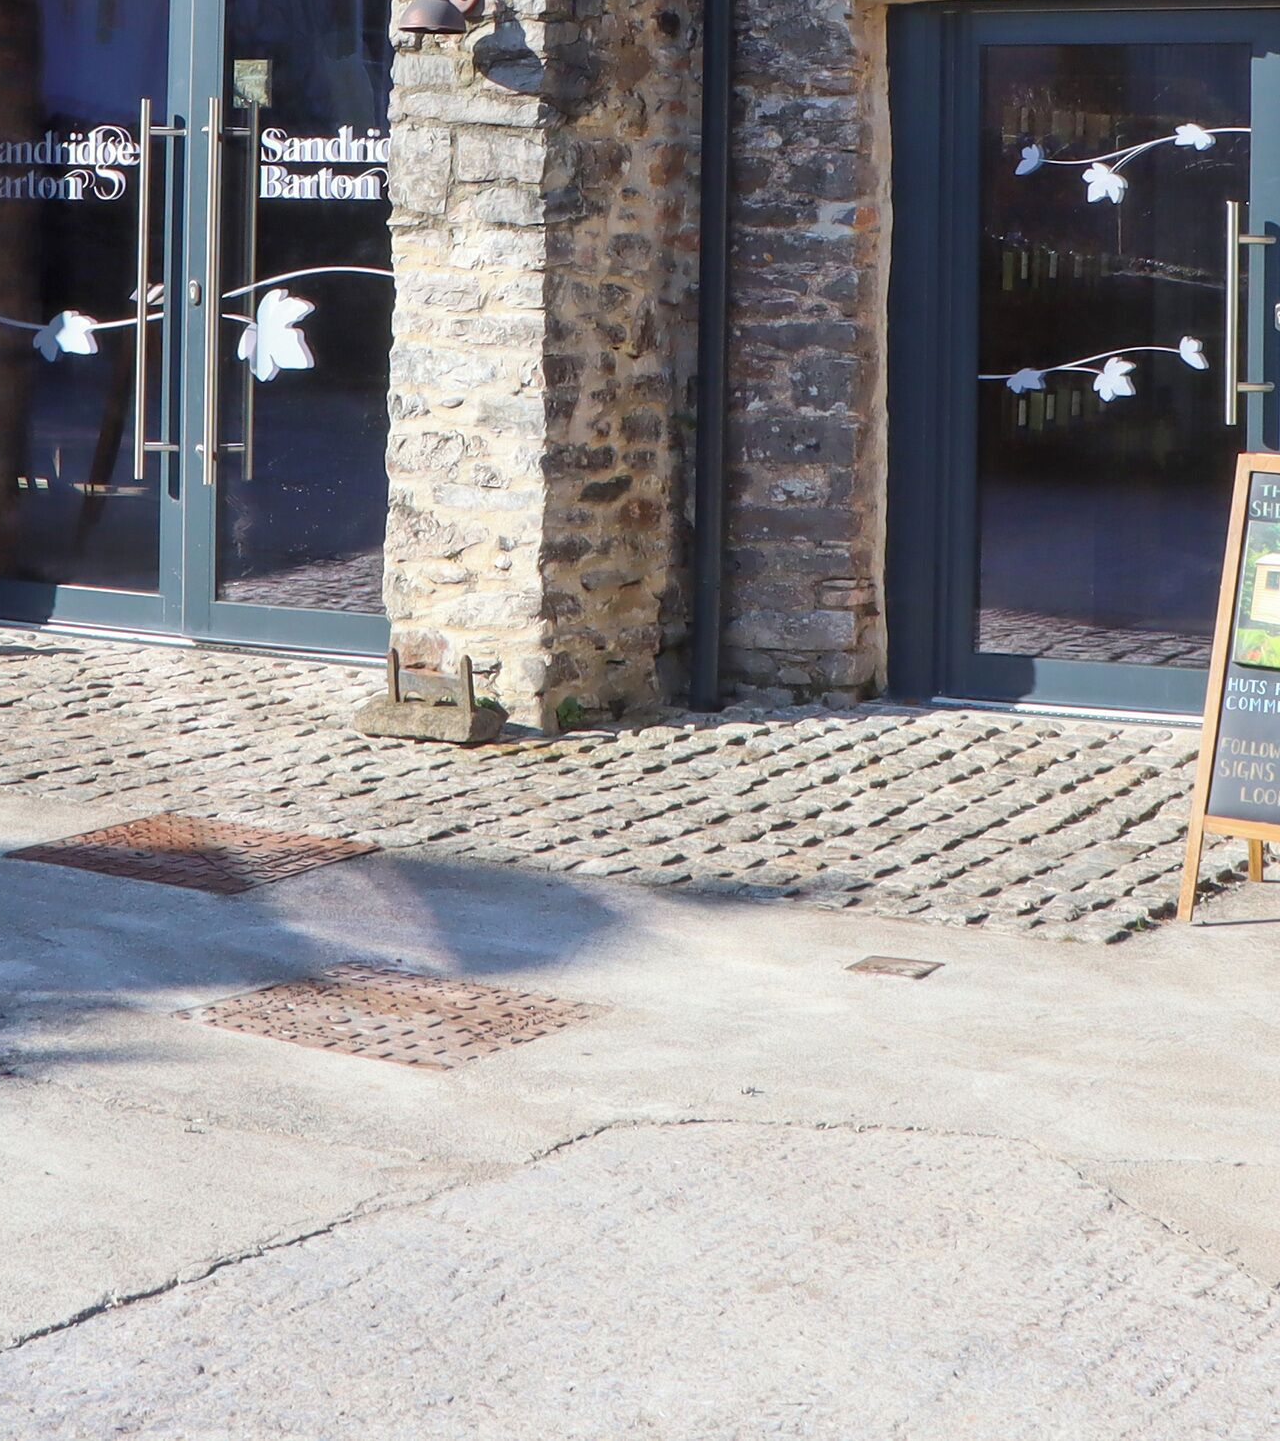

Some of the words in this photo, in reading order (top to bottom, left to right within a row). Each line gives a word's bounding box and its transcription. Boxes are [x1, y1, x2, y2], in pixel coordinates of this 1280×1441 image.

[260, 165, 389, 200] Barton
[1228, 677, 1268, 695] HUTS
[1219, 758, 1277, 783] SIGNS
